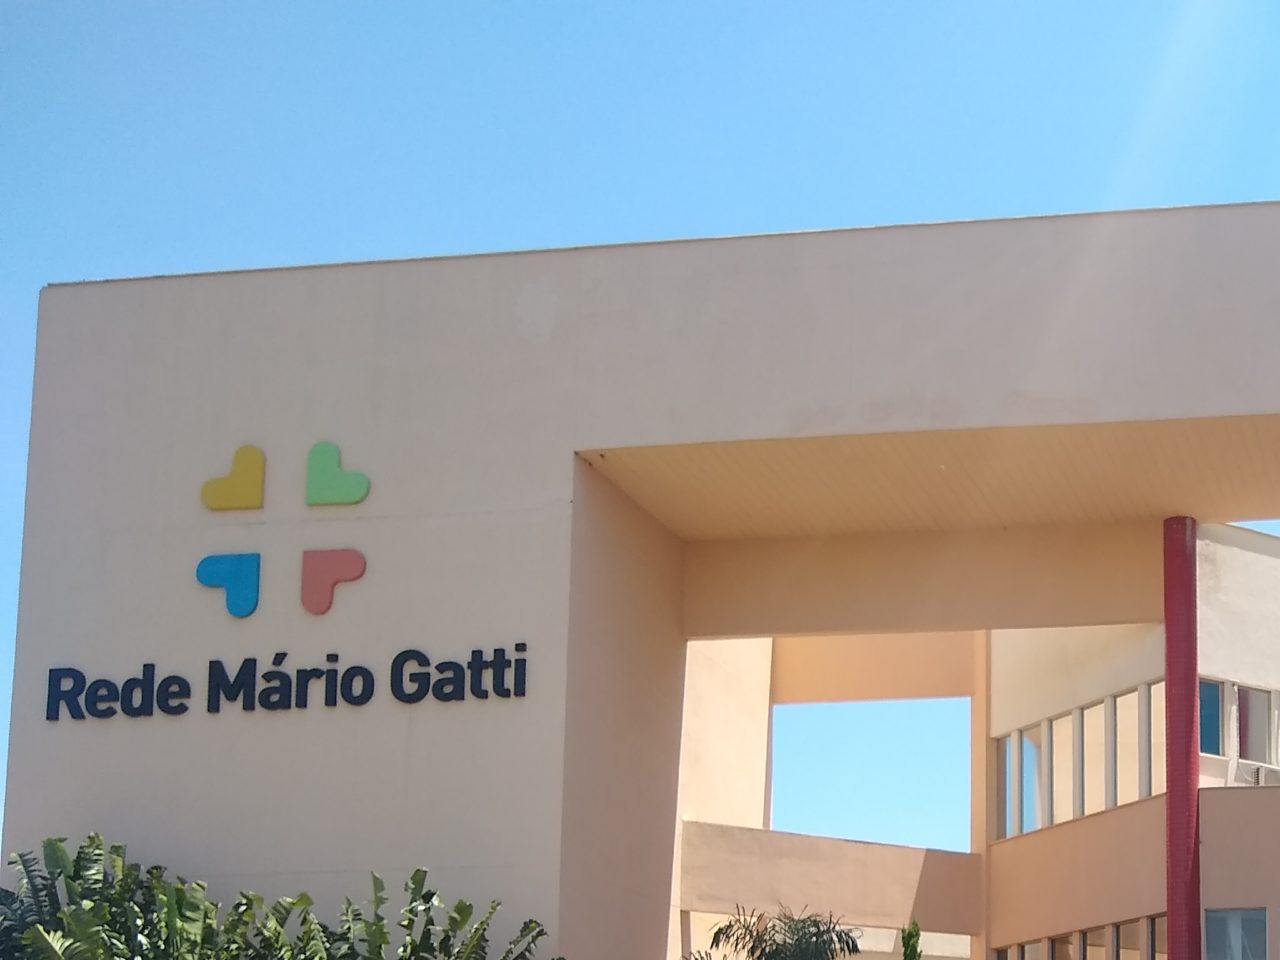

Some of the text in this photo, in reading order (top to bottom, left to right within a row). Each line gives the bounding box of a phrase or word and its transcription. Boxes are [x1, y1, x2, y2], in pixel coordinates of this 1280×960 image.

[46, 643, 528, 721] Rede Mário Gatti
